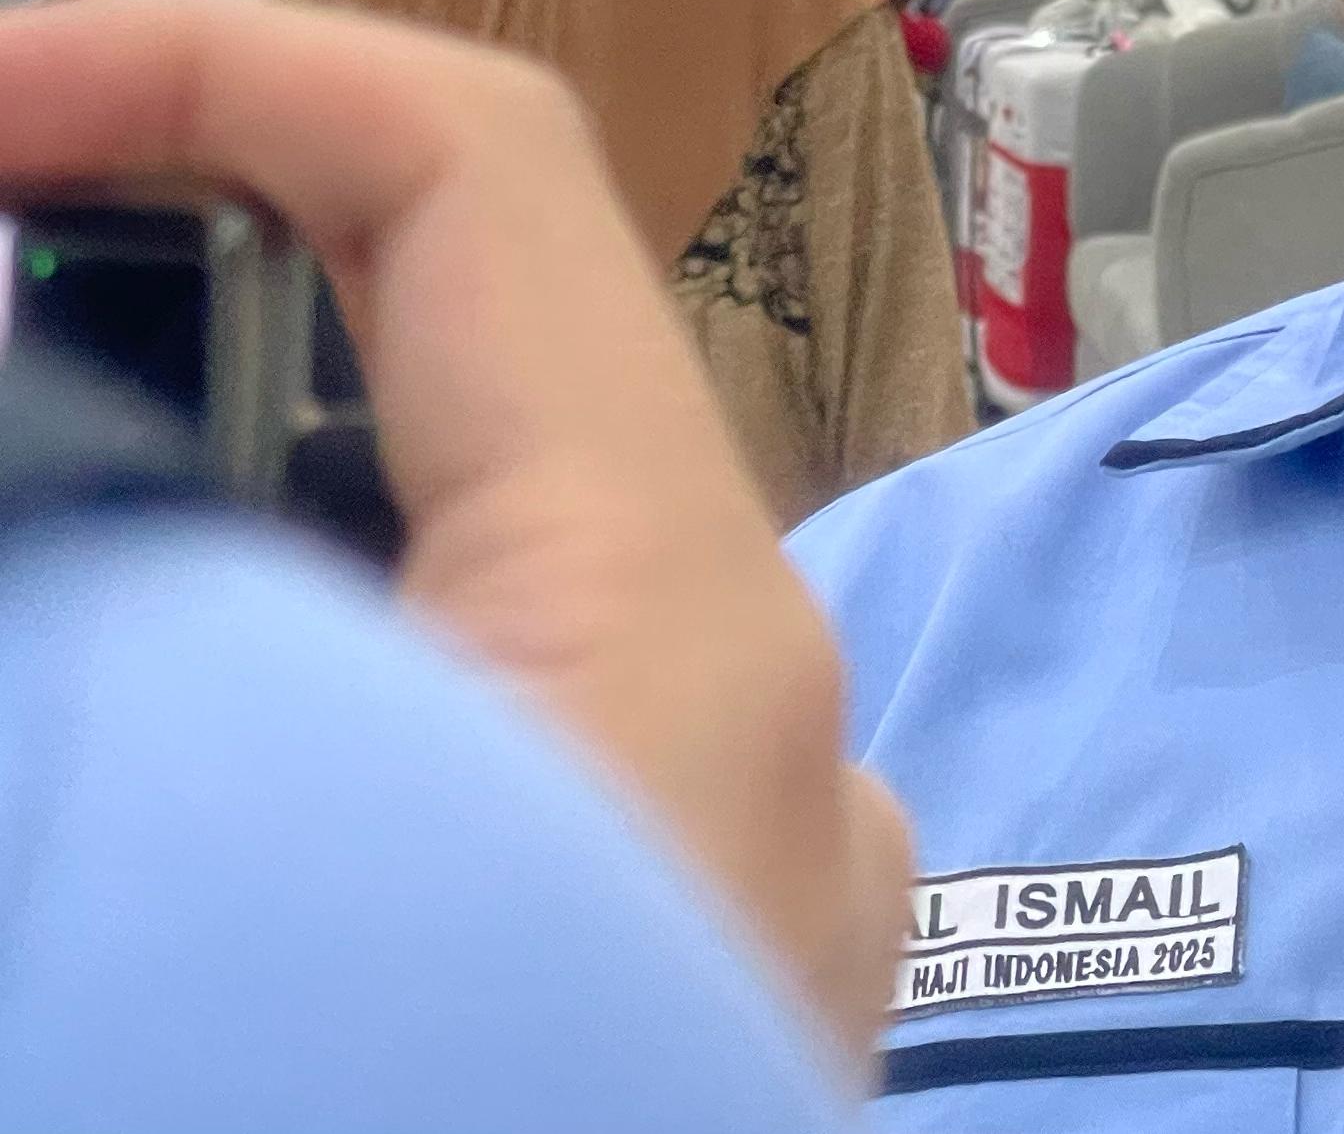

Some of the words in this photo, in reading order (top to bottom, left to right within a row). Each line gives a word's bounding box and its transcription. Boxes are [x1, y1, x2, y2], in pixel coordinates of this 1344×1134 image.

[912, 892, 959, 941] L
[994, 869, 1220, 930] ISMAIL
[912, 955, 970, 1000] HAJI
[983, 945, 1141, 989] INDONESIA
[1150, 935, 1216, 975] 2025
